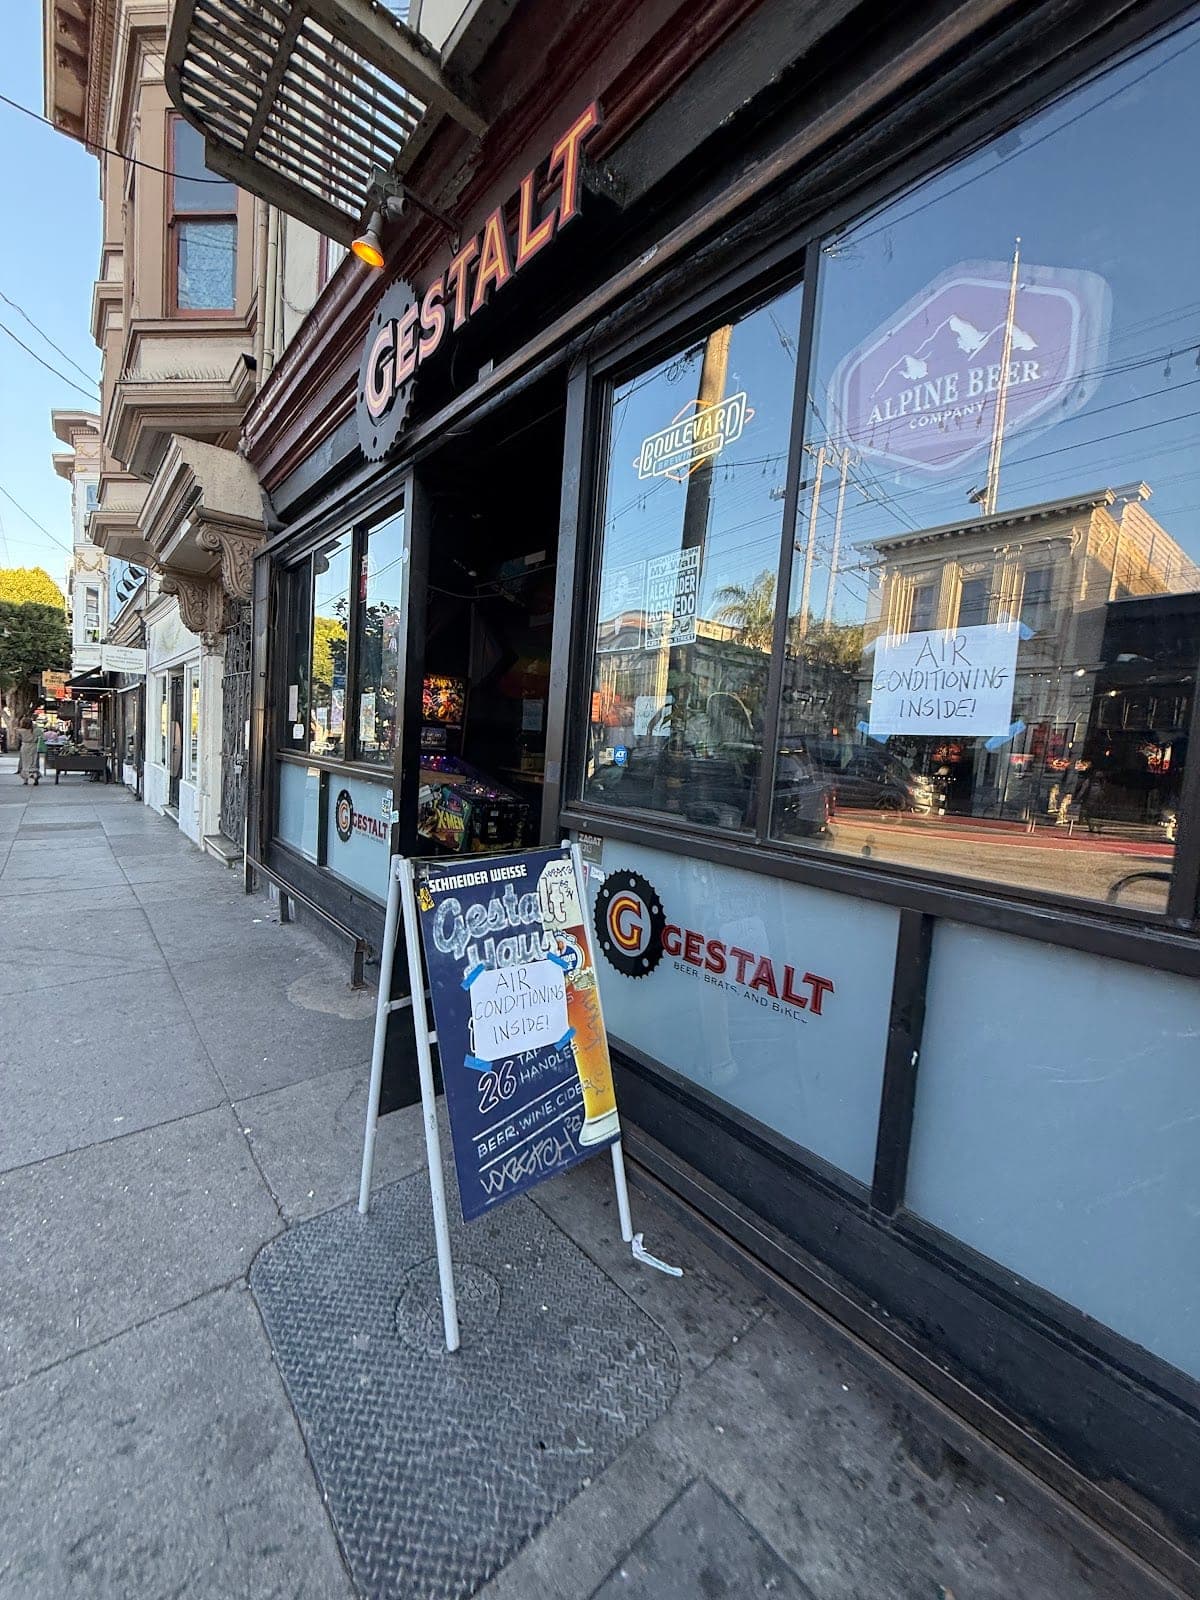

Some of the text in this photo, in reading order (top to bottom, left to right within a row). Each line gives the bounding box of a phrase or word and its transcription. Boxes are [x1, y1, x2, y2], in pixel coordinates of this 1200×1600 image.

[364, 101, 600, 419] GESTALT
[866, 360, 1041, 426] ALPINE BEER
[909, 403, 985, 429] COMPANY
[642, 402, 740, 471] BOULEVARD
[915, 635, 972, 668] AIR
[873, 666, 1009, 693] CONDITIONING
[899, 697, 977, 719] INSIDE!
[352, 811, 388, 840] GESTALT
[579, 833, 602, 847] ZAGAT
[429, 870, 489, 893] SCHNEIDER
[490, 864, 528, 882] WEISSE
[433, 876, 567, 961] Gestalt
[608, 896, 643, 951] G
[495, 967, 532, 993] AIR
[660, 924, 835, 1016] GESTALT
[474, 984, 564, 1021] CONDITIONING
[743, 991, 768, 1007] AND
[493, 1014, 550, 1045] INSIDE!
[478, 1060, 517, 1114] 26
